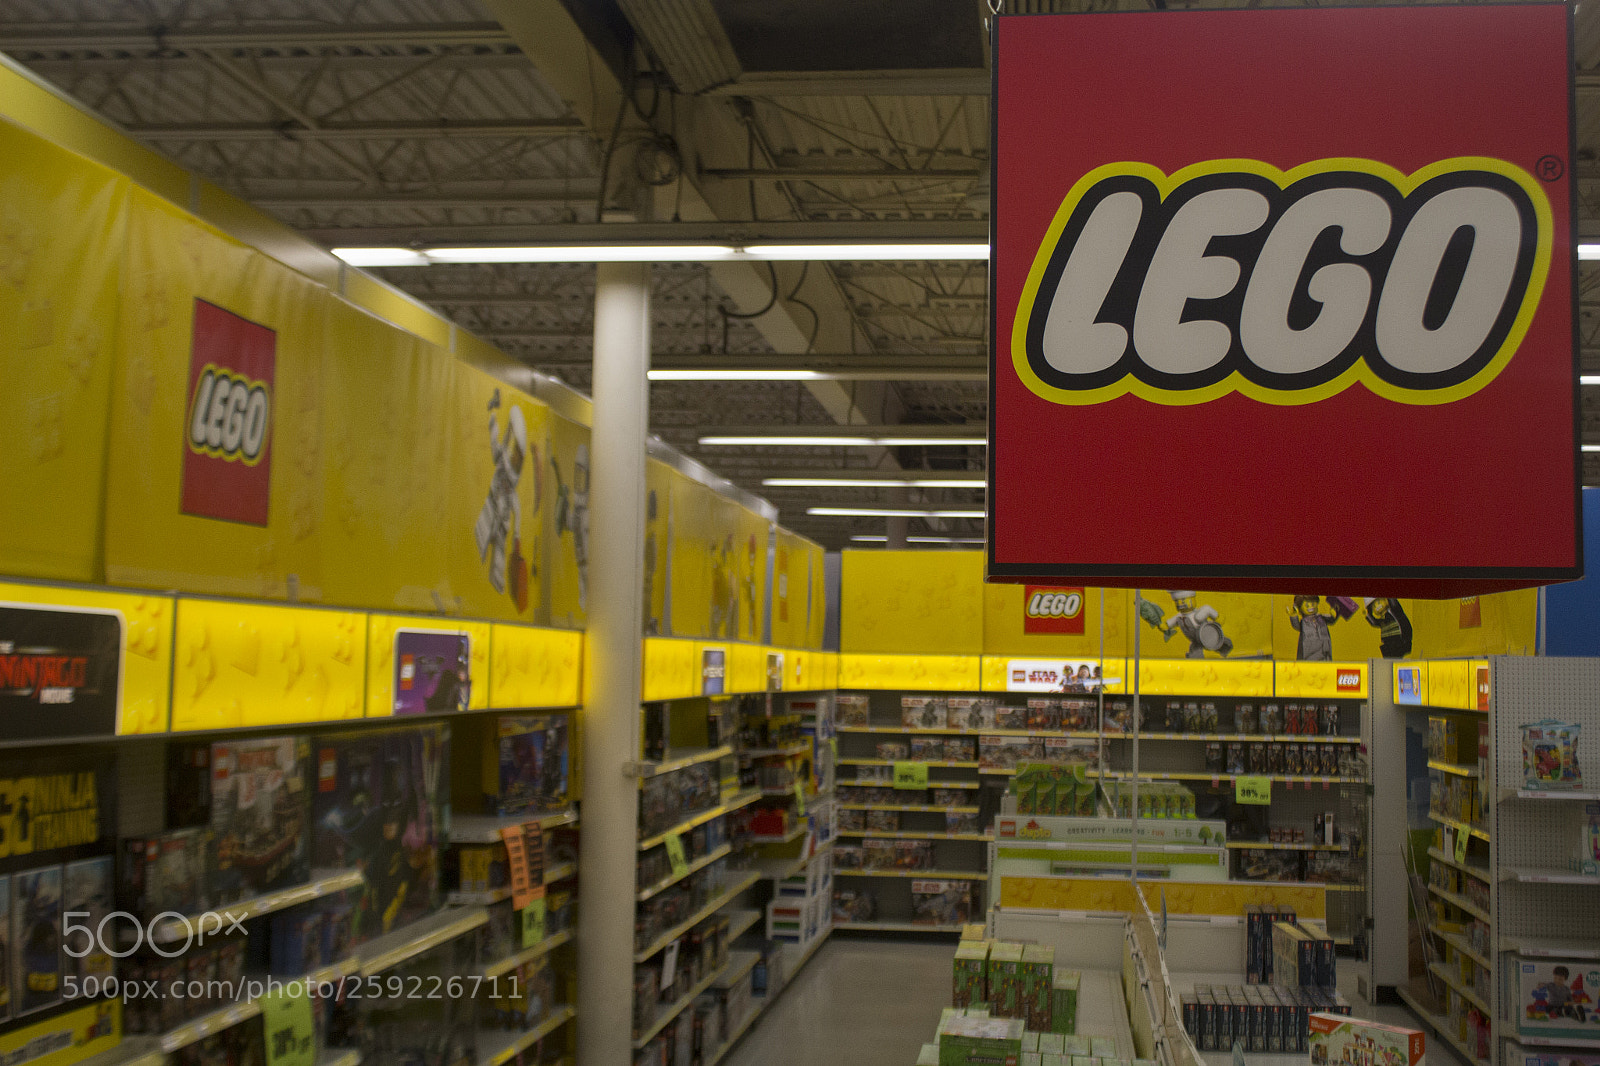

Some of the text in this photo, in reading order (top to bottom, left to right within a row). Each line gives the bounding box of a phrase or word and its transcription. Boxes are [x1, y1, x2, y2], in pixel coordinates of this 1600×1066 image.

[1030, 174, 1533, 388] LEGO
[188, 366, 270, 461] LEGO
[1027, 591, 1082, 617] LEGO
[1337, 673, 1360, 686] LEGO
[1019, 825, 1052, 840] duplo
[1067, 827, 1105, 835] CREATIVITY
[1112, 828, 1145, 836] LEARNNG
